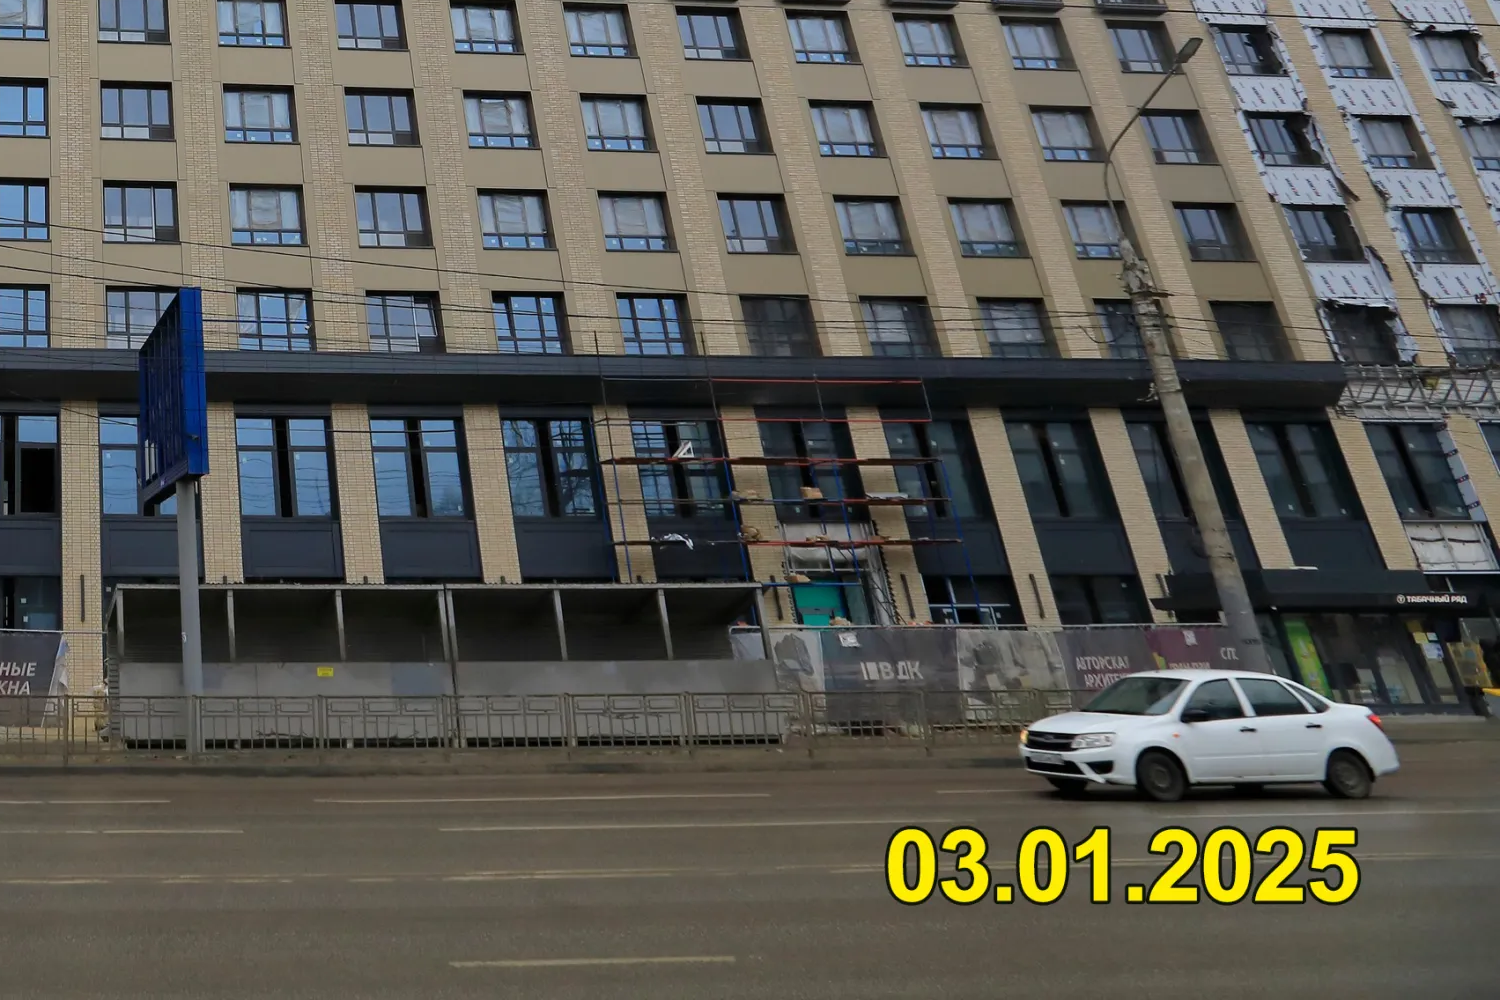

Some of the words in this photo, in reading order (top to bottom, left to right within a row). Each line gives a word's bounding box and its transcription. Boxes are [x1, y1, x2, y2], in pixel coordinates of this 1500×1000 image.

[1406, 594, 1450, 603] ТАБАЧНЫЙ
[1451, 595, 1468, 604] РЯД
[879, 661, 924, 680] ВДК
